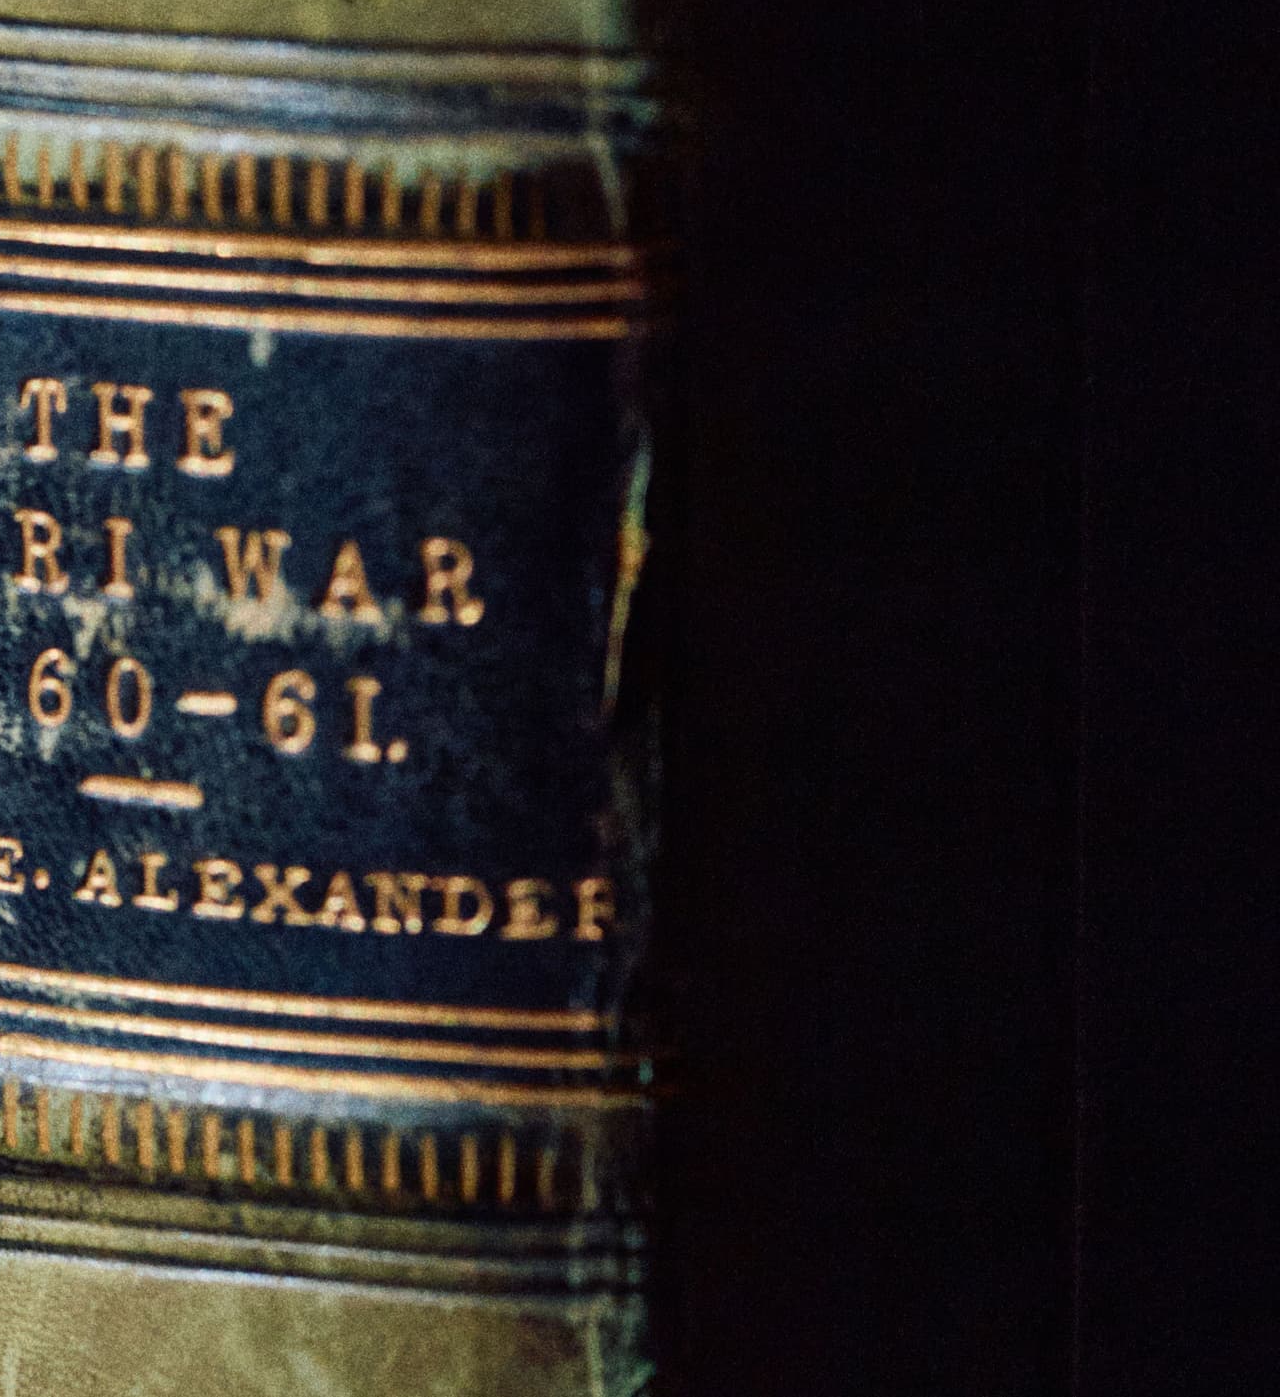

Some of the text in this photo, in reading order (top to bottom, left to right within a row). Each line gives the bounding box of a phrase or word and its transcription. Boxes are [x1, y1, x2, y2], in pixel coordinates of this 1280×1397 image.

[19, 376, 236, 477] THE
[214, 526, 486, 626] WAR
[72, 848, 618, 942] ALEXANDER
